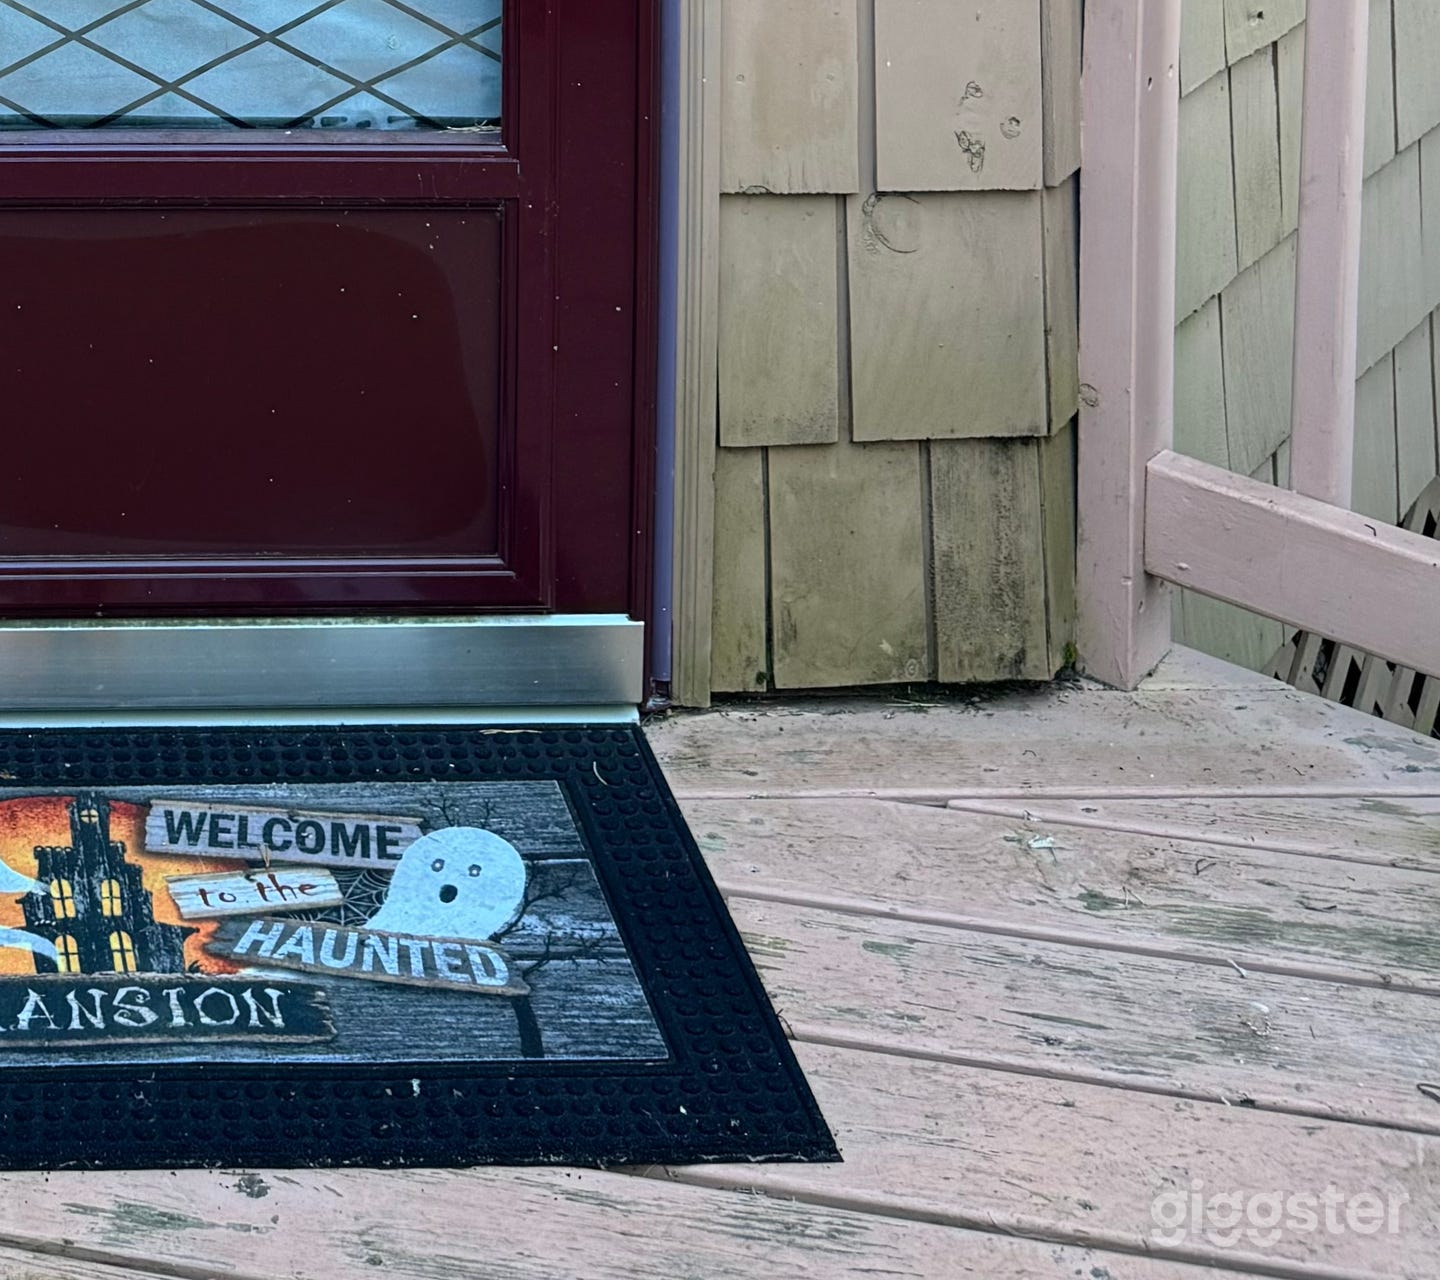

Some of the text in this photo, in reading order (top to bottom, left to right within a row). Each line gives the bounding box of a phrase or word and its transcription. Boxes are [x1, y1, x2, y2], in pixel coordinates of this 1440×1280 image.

[163, 809, 405, 861] WELCOME
[196, 871, 320, 907] to the
[232, 918, 509, 987] HAUNTED
